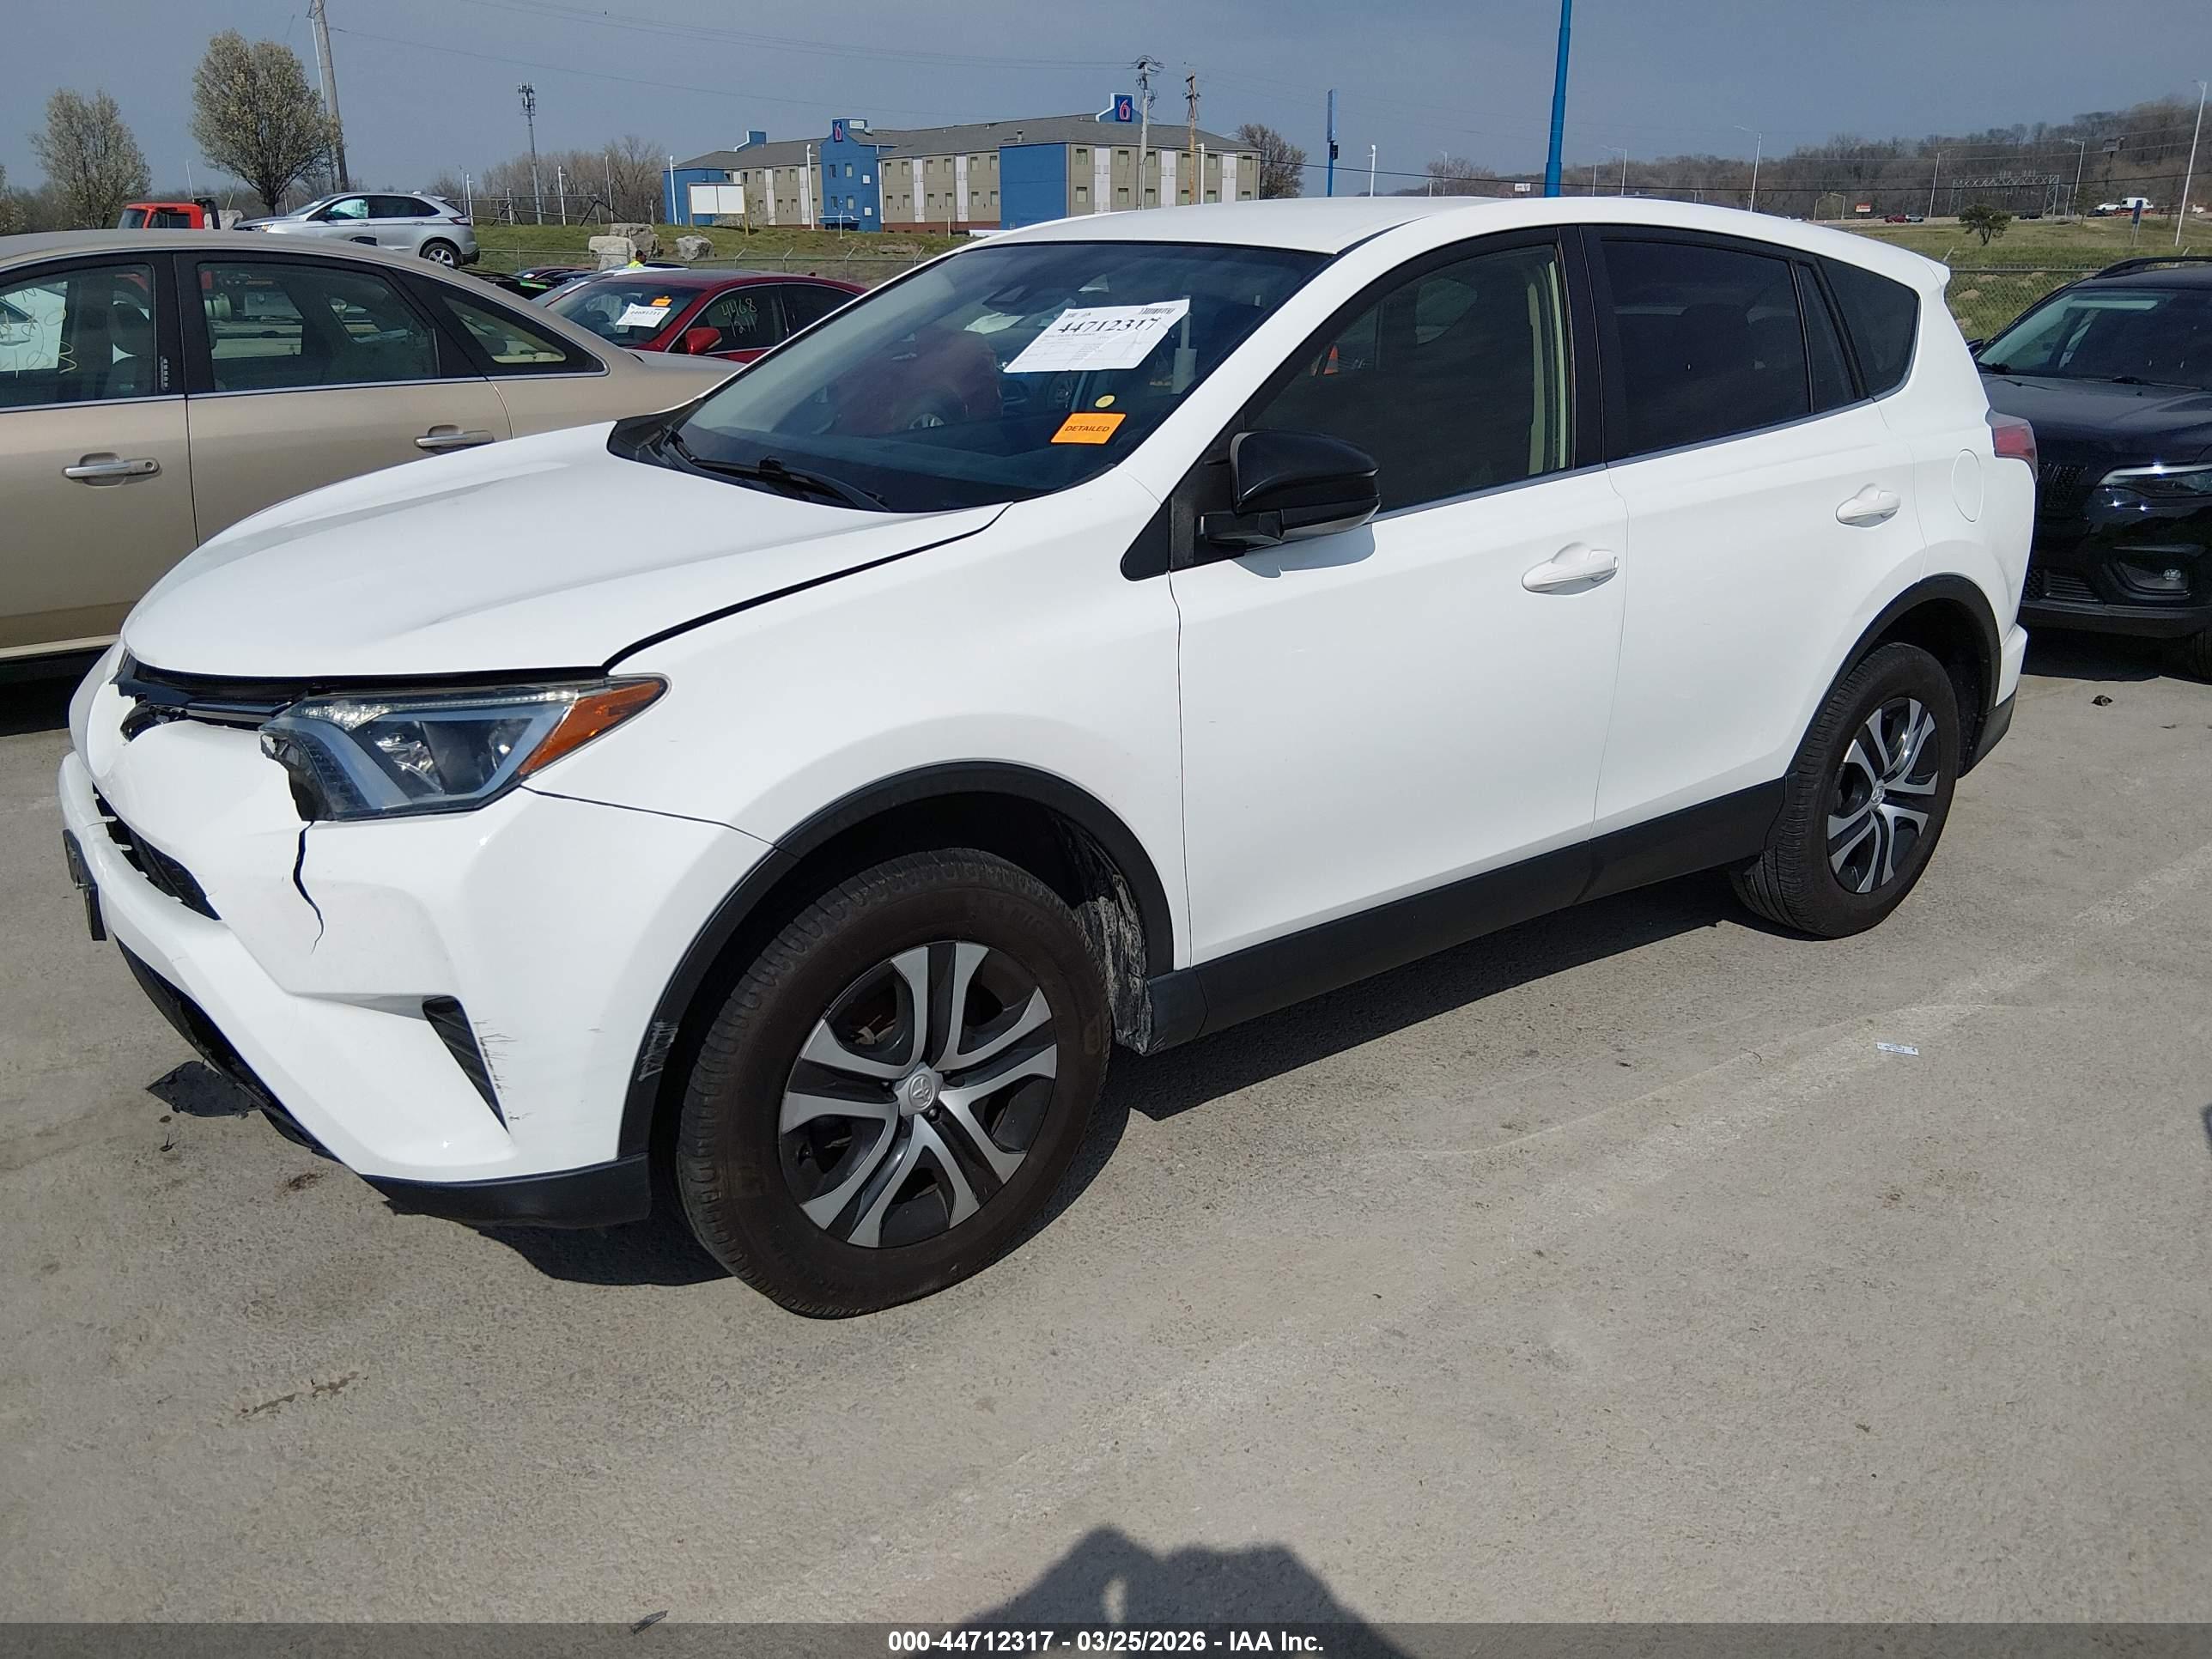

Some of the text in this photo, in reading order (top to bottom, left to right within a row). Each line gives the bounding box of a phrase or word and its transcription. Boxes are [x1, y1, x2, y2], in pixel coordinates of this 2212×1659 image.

[1119, 99, 1131, 120] 6
[834, 122, 842, 141] 6
[720, 298, 757, 318] 4468
[731, 314, 757, 337] 1211
[1058, 316, 1162, 333] 44712317
